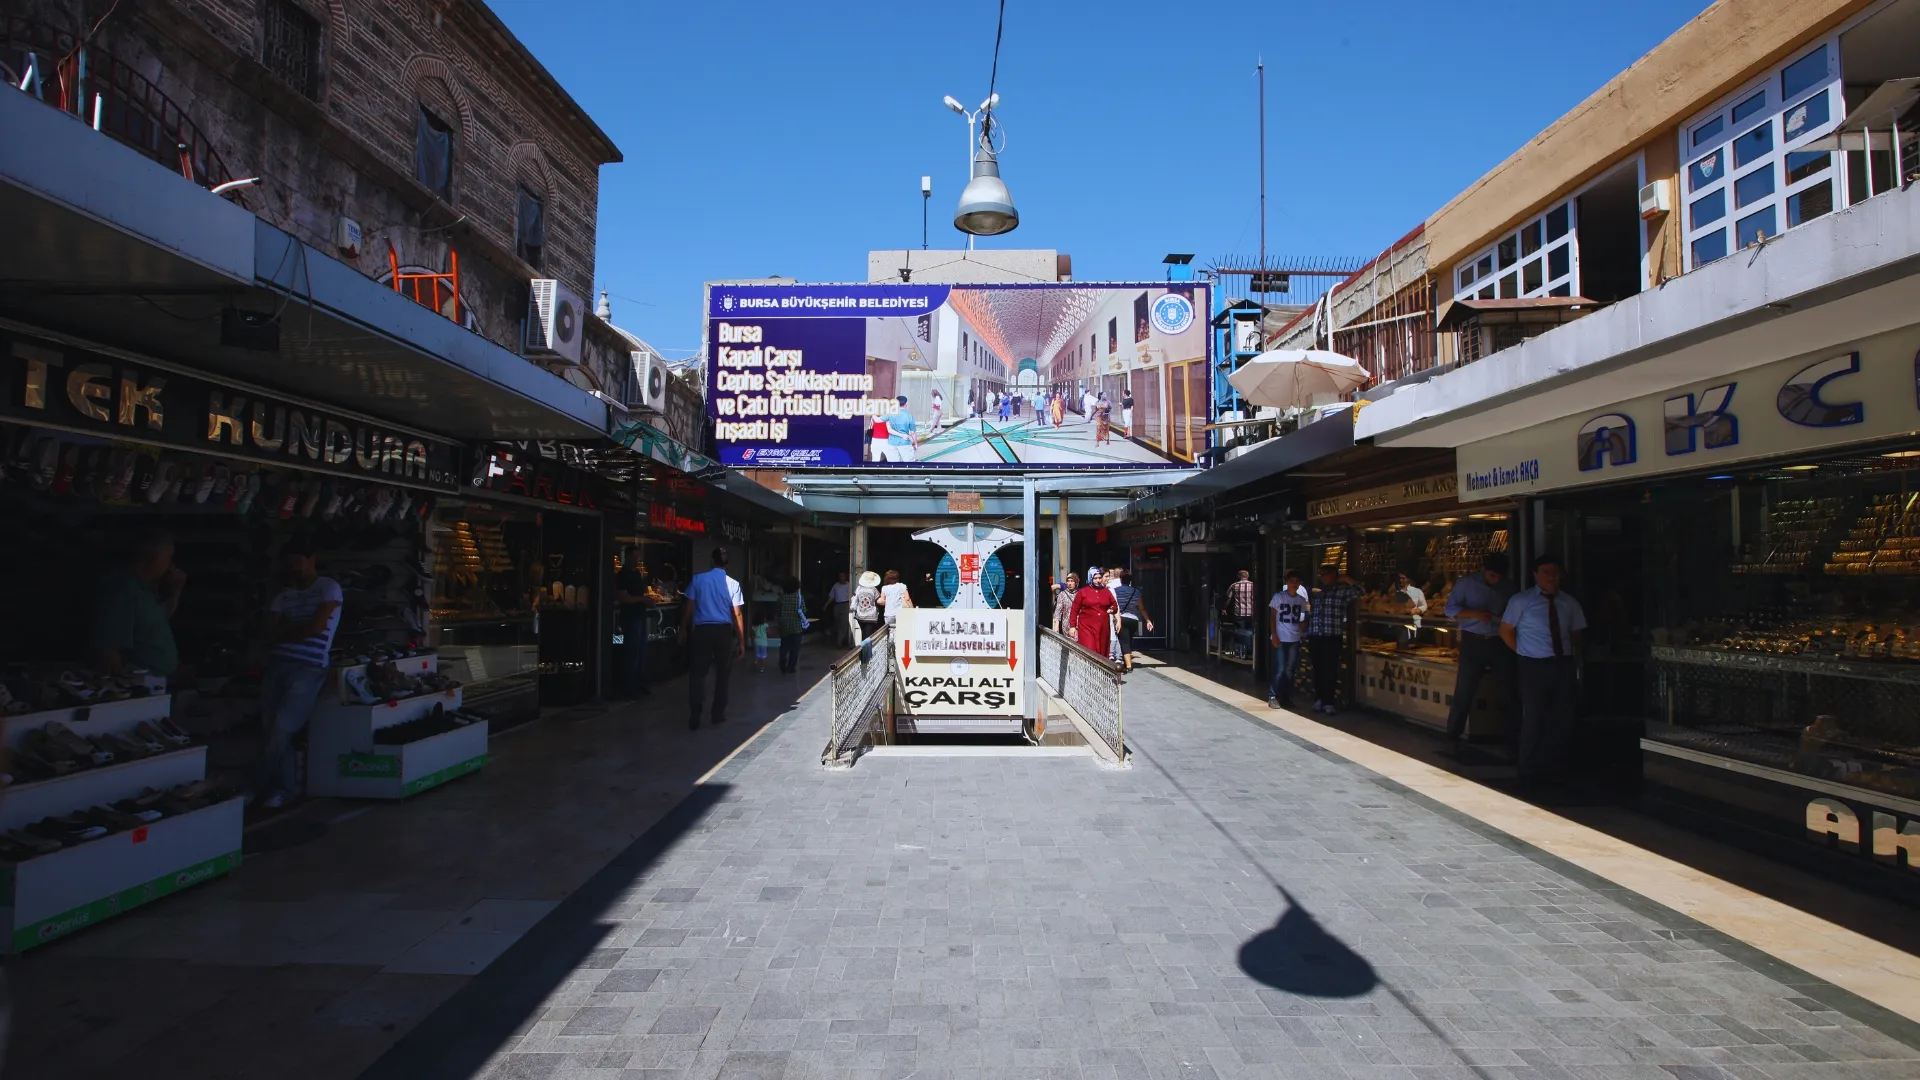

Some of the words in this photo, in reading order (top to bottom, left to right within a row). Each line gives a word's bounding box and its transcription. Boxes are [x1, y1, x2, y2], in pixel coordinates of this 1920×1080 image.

[739, 298, 780, 308] BURSA
[781, 296, 857, 310] BÜYÜKŞEHİR
[859, 296, 928, 308] BELEDİYESİ
[718, 322, 763, 343] Bursa
[718, 345, 763, 371] Kapalı
[764, 345, 803, 371] Çarşı
[11, 341, 168, 432] TEK
[716, 370, 765, 395] Cephe
[765, 369, 874, 395] Sağlıklaştırma
[716, 397, 736, 416] ve
[737, 393, 769, 419] Çatı
[770, 390, 822, 416] Örtüsü
[823, 393, 900, 420] Uygulama
[207, 390, 427, 480] KUNDURA
[1466, 471, 1492, 492] Mehmet
[1492, 467, 1499, 488] &
[1279, 603, 1302, 624] 29
[928, 617, 995, 635] KLİMALI
[905, 676, 974, 687] KAPALI
[978, 677, 1014, 688] ALT
[904, 690, 1016, 709] ÇARŞI
